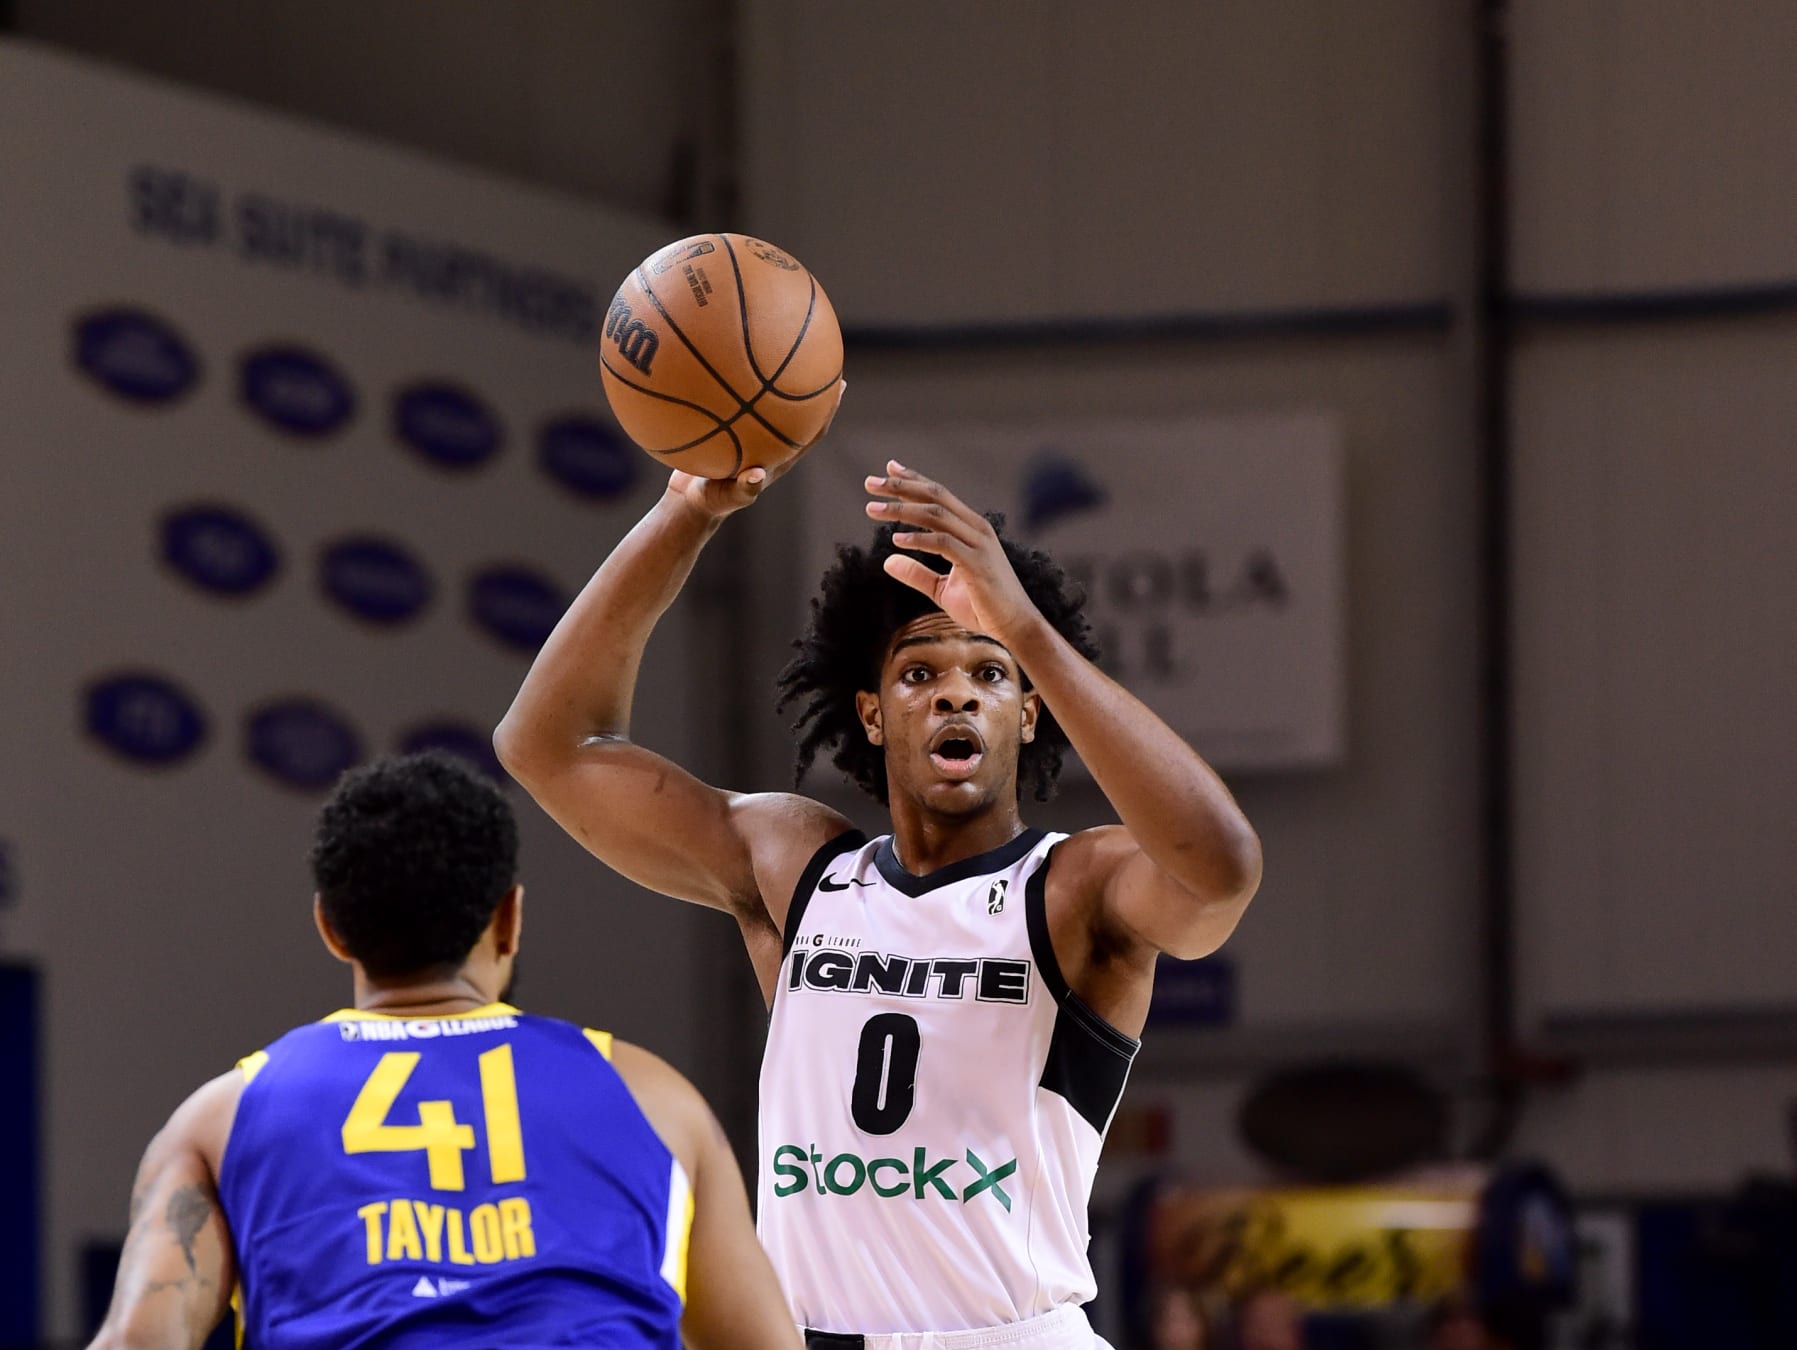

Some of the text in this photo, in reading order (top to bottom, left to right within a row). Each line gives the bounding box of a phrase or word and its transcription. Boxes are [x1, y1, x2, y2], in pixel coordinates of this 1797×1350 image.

[788, 949, 1031, 1005] IGNITE
[851, 1012, 921, 1137] 0
[341, 1043, 526, 1192] 41
[773, 1143, 1017, 1214] StockX
[357, 1197, 536, 1266] TAYLOR
